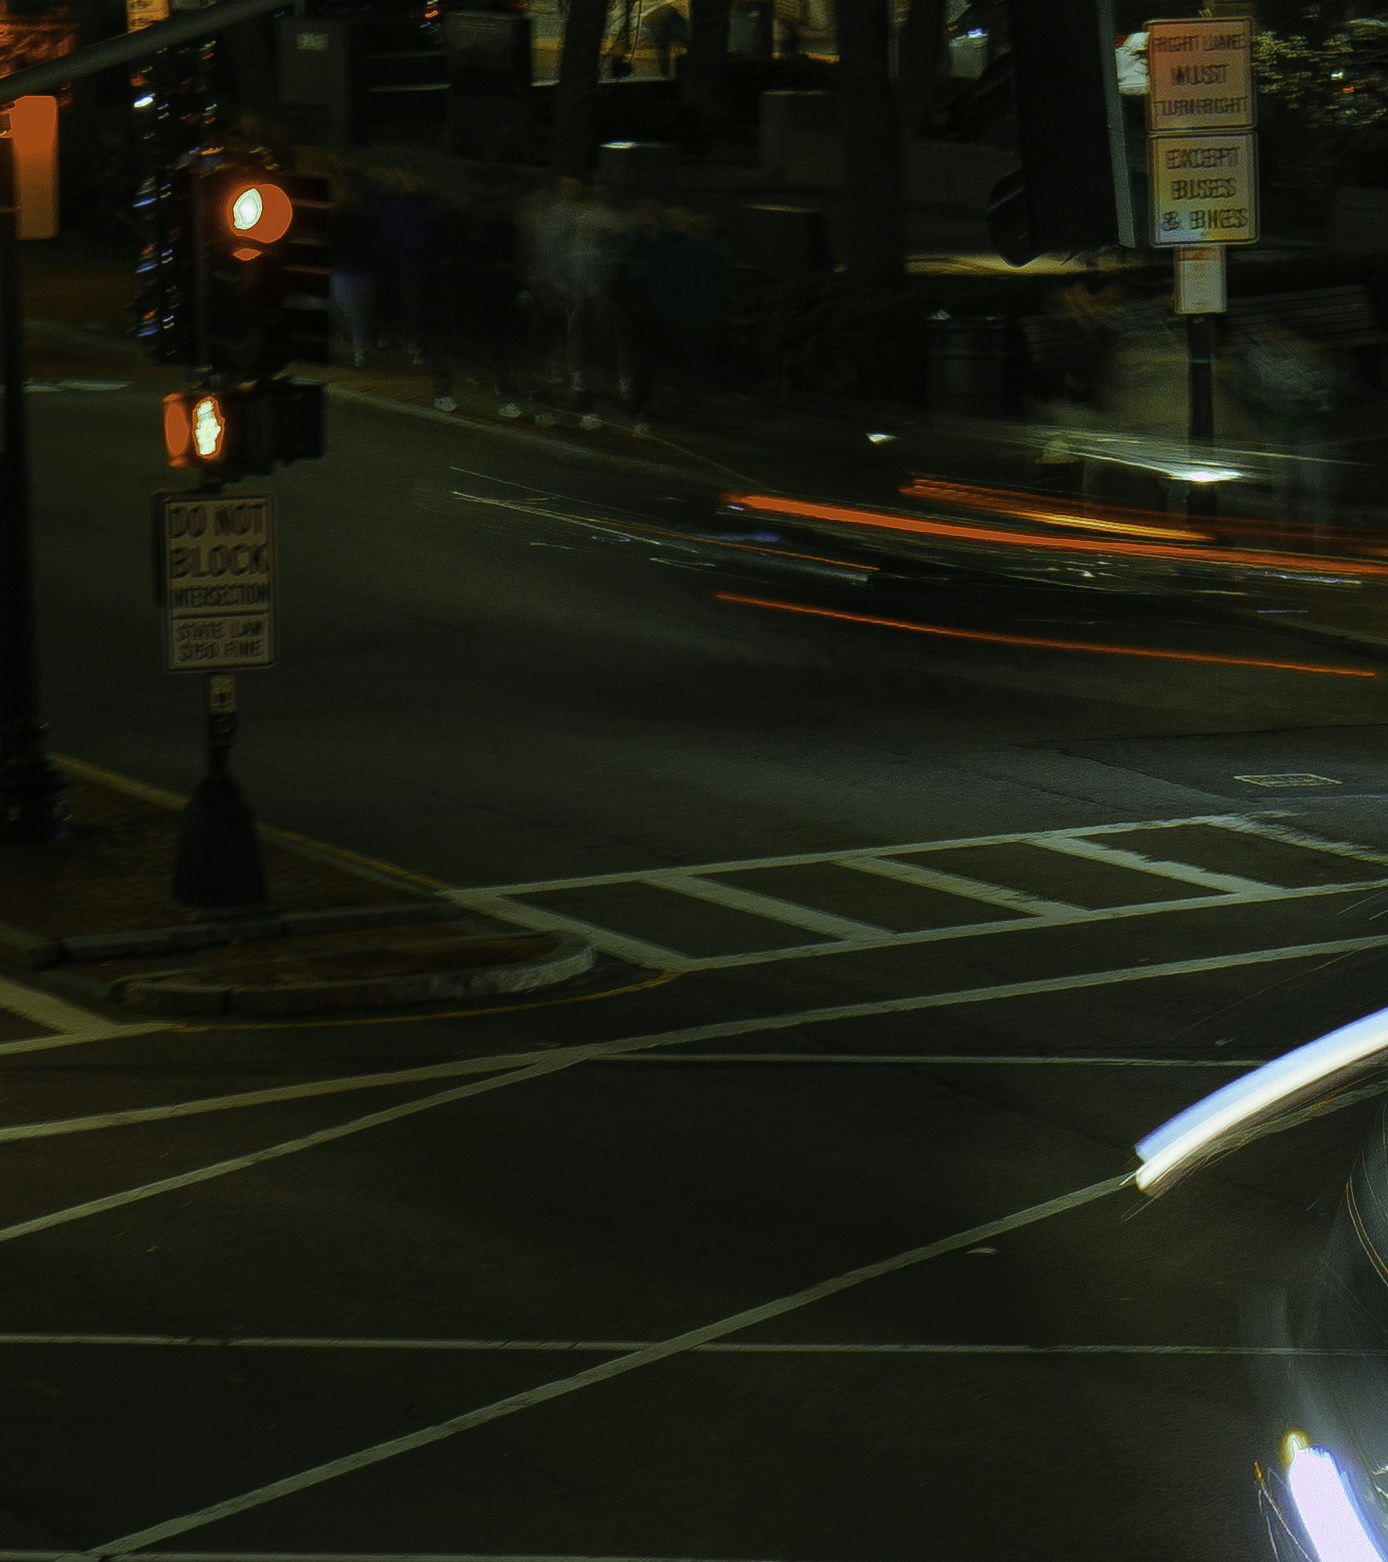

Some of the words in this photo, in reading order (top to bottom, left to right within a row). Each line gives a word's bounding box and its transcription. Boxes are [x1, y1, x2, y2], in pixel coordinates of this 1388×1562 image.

[1151, 35, 1199, 52] RIGHT
[1170, 63, 1229, 86] MUST
[1153, 98, 1196, 116] TURN
[1197, 96, 1248, 114] RIGHT
[1166, 146, 1240, 170] EXCEPT
[1171, 176, 1237, 200] BUSES
[1162, 210, 1181, 231] &
[1188, 207, 1248, 230] BIKES
[169, 507, 207, 539] DO
[214, 504, 264, 536] NOT
[169, 543, 268, 579] BLOCK
